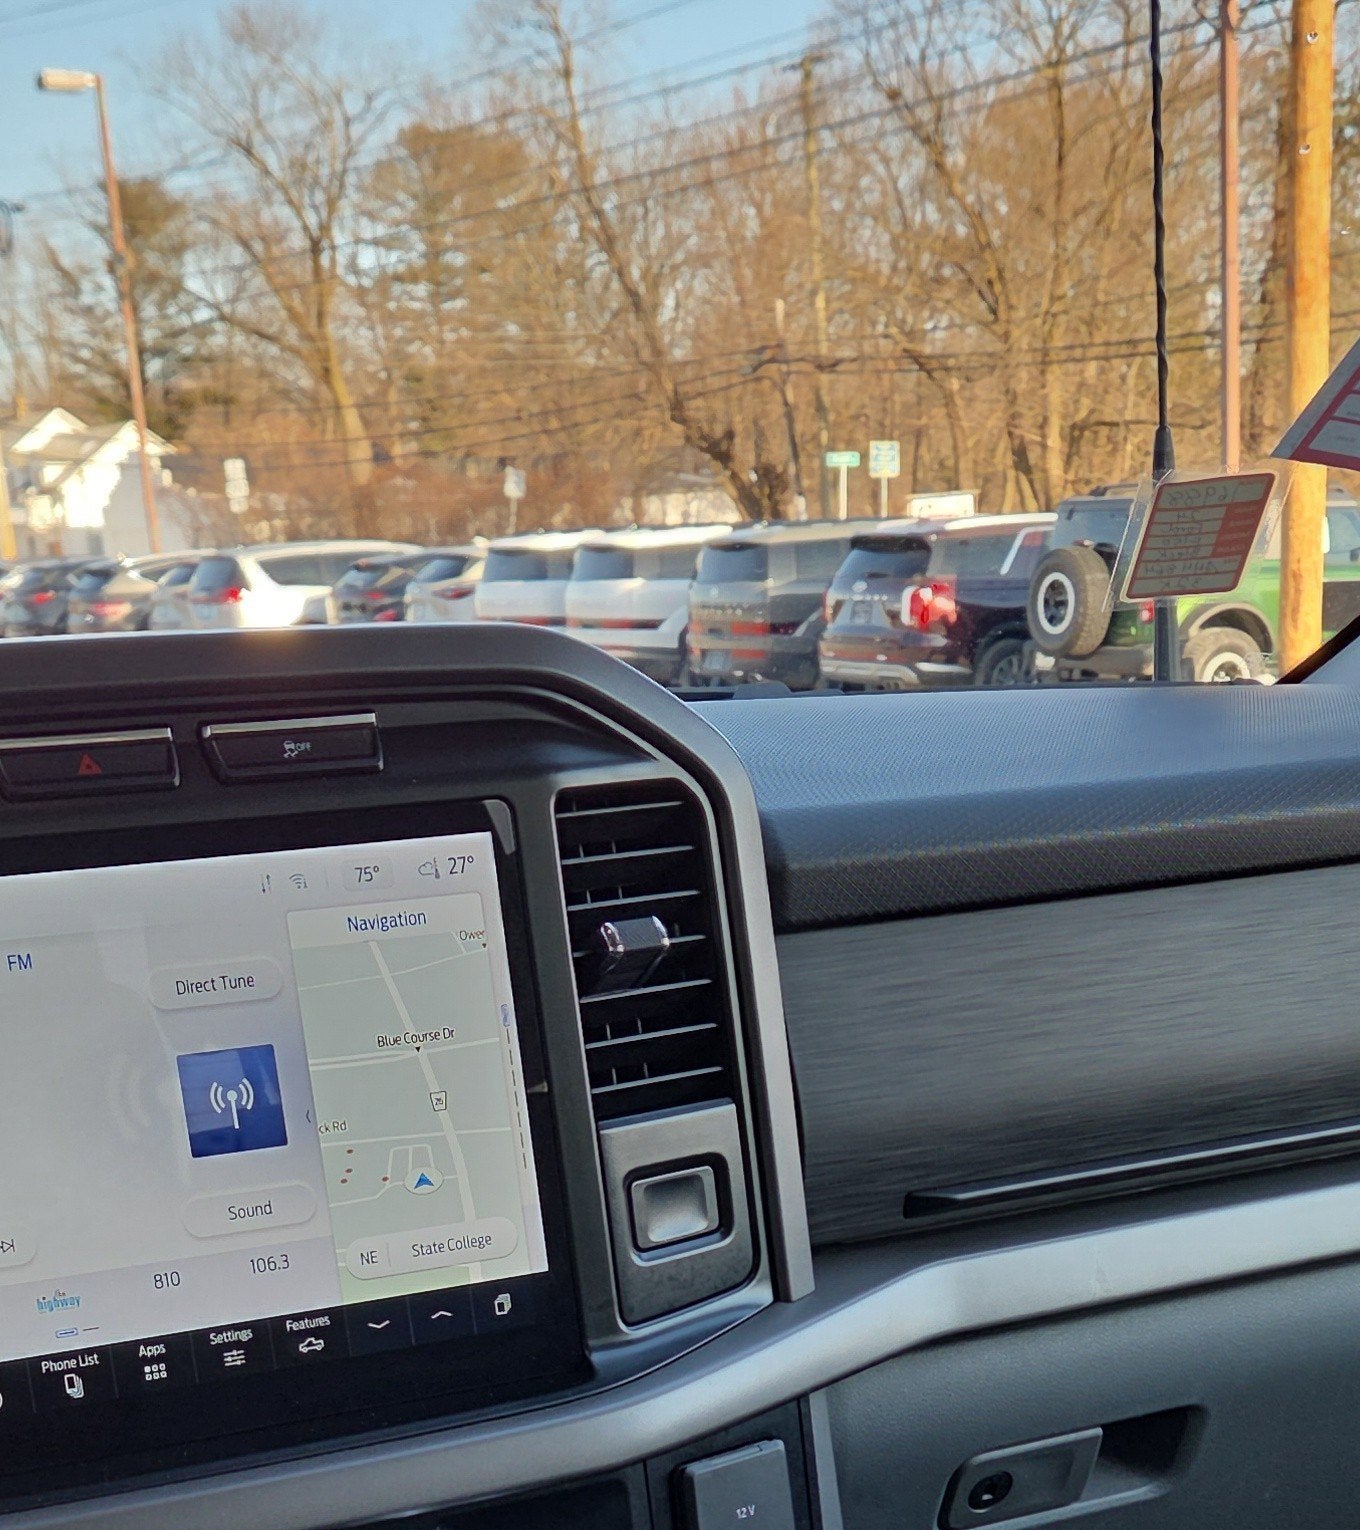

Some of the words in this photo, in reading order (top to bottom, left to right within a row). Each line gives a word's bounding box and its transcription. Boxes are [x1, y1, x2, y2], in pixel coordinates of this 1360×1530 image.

[347, 910, 427, 933] Navigation
[7, 953, 33, 972] FM
[176, 977, 216, 996] Direct
[219, 973, 255, 991] Tune
[377, 1033, 402, 1047] Blue
[403, 1029, 440, 1044] Course
[441, 1027, 455, 1040] Dr
[332, 1120, 347, 1132] Rd
[228, 1201, 273, 1221] Sound
[411, 1241, 445, 1258] State
[447, 1232, 492, 1253] College
[250, 1254, 291, 1276] 106.3
[360, 1250, 379, 1266] NE
[153, 1271, 181, 1290] 810
[286, 1314, 331, 1332] Features
[209, 1327, 253, 1346] Settings
[139, 1342, 167, 1358] Apps
[41, 1357, 75, 1374] Phone
[76, 1352, 100, 1368] List
